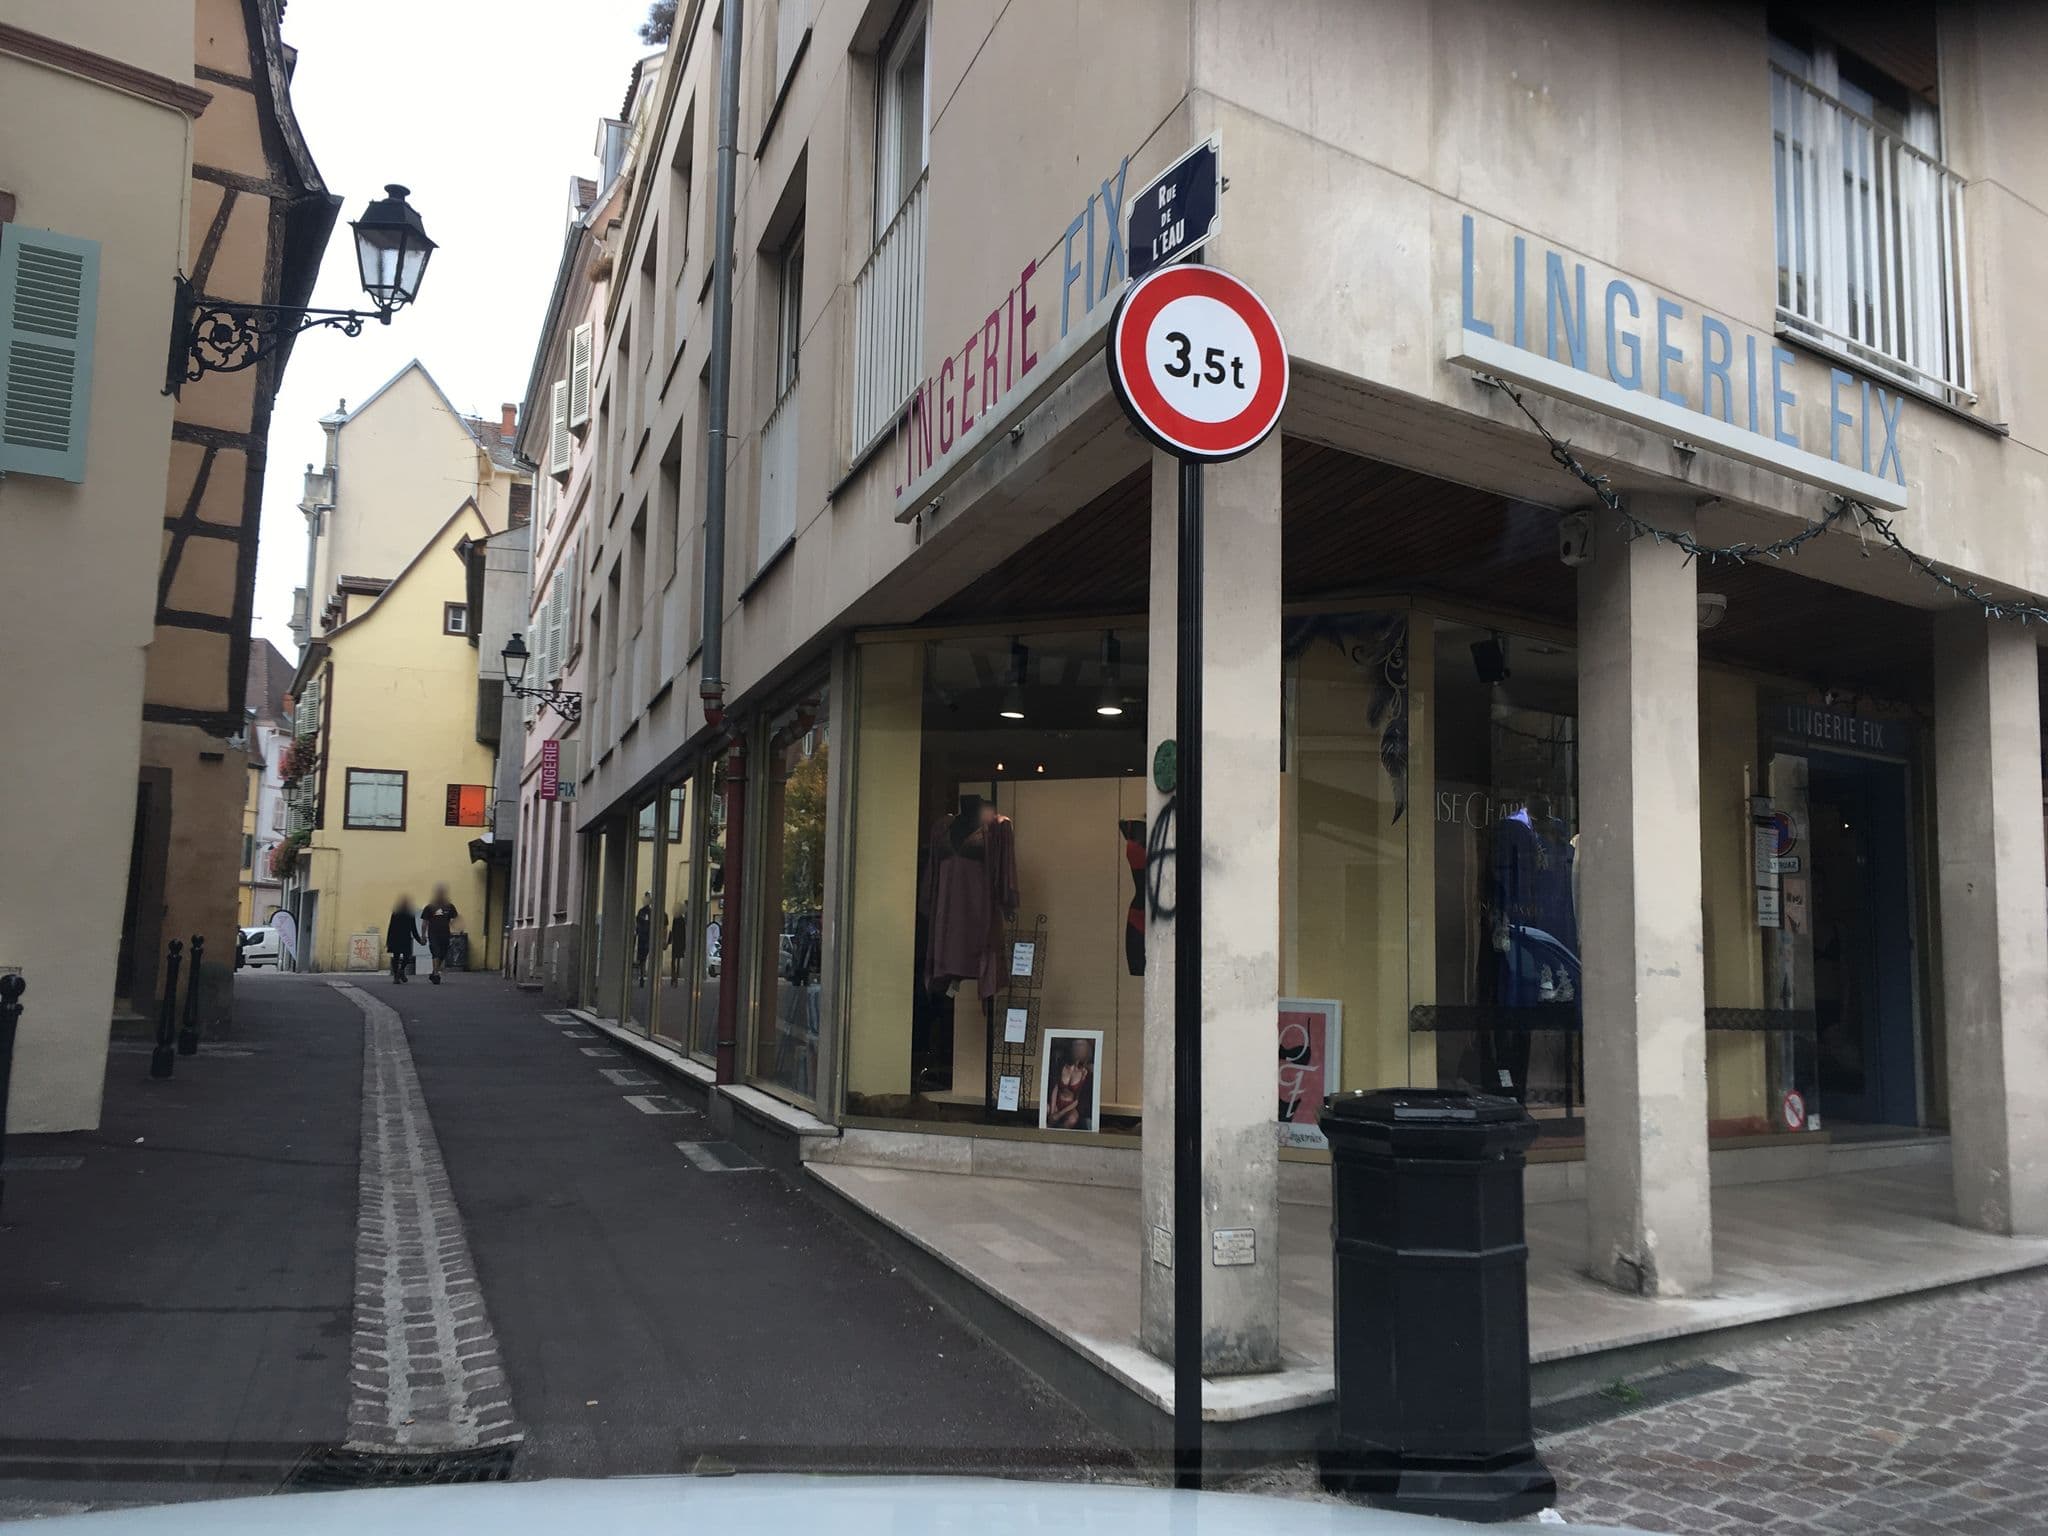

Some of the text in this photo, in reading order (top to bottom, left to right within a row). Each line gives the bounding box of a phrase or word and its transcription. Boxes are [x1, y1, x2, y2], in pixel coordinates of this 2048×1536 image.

[1152, 219, 1185, 262] L'EAU
[1161, 207, 1172, 225] DE
[896, 154, 1129, 499] LINGERIE FIX
[1462, 213, 1907, 487] LINGERIE FIX
[1164, 331, 1245, 390] 3,5t
[1787, 706, 1884, 750] LINGERIE FIX
[543, 741, 558, 797] LINGERIE
[558, 781, 577, 797] FIX
